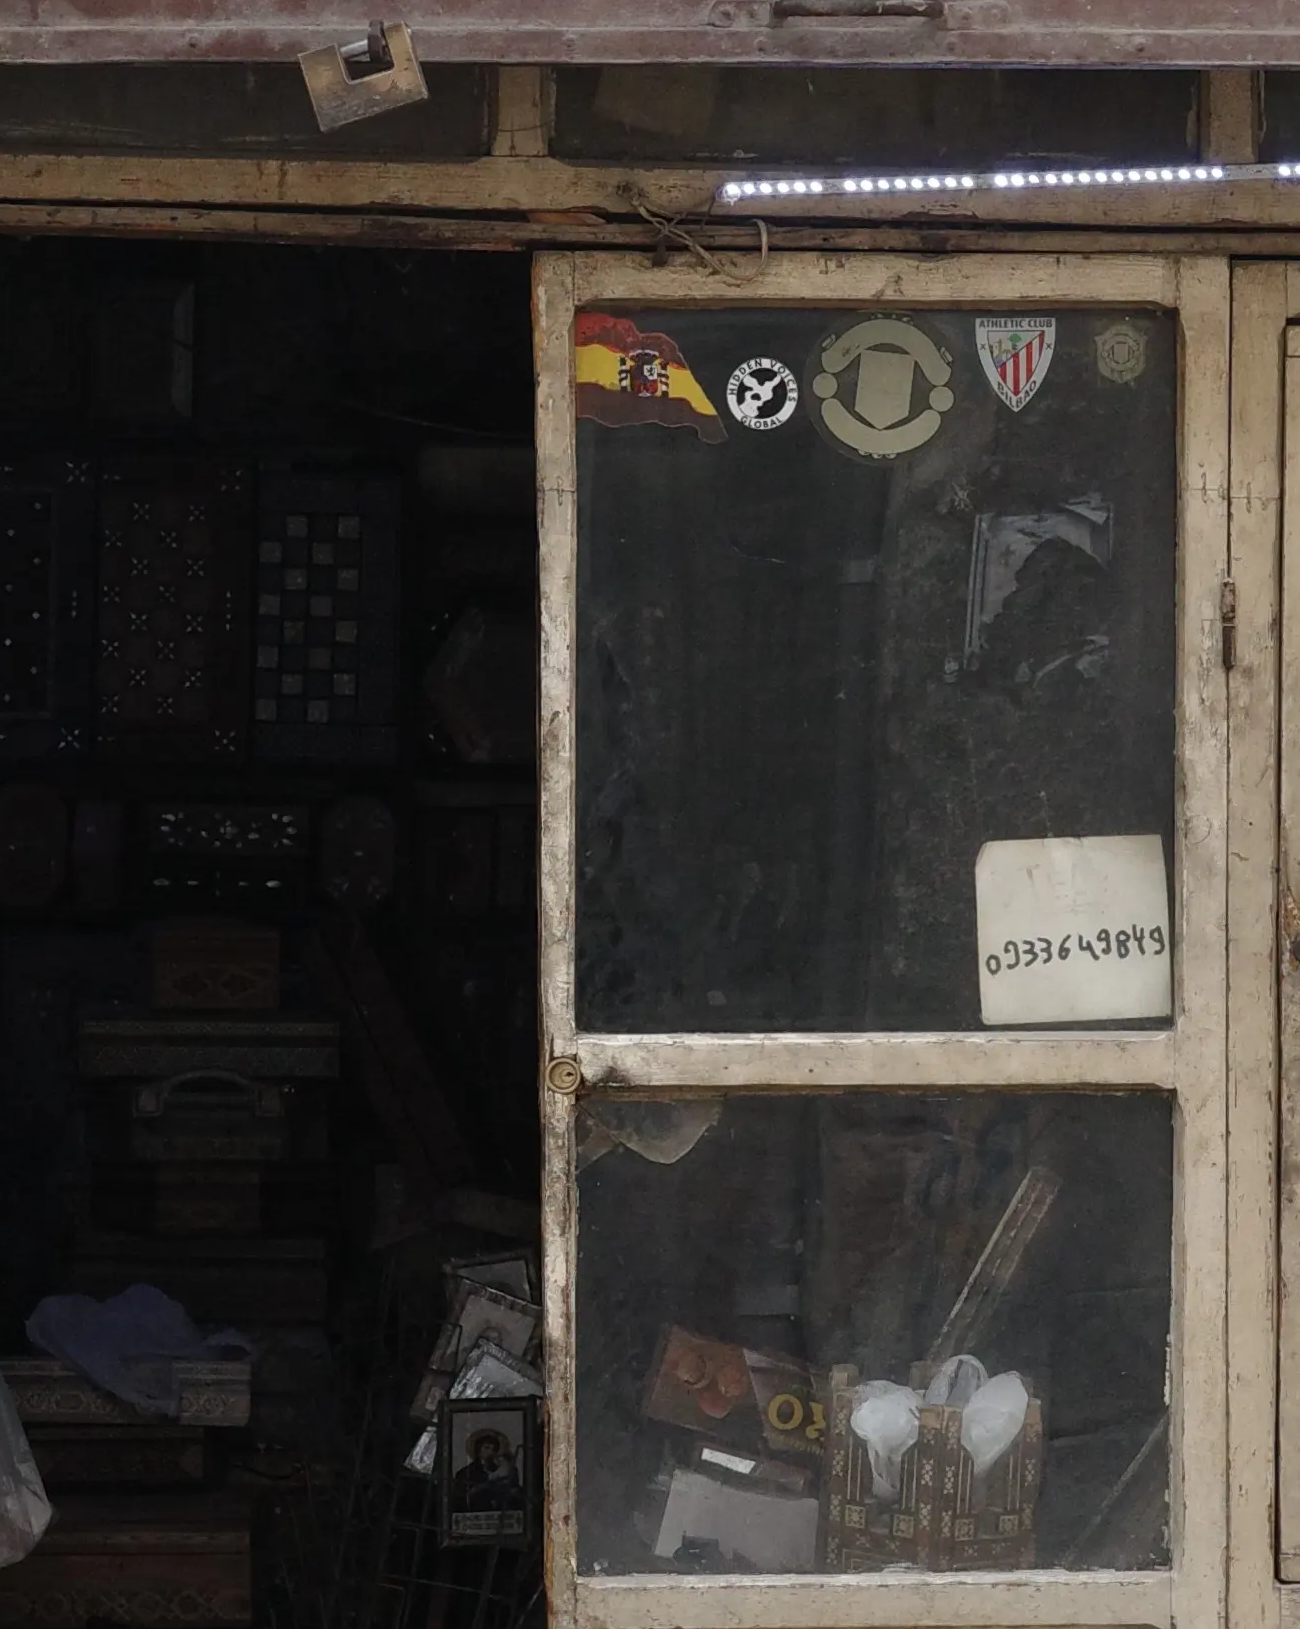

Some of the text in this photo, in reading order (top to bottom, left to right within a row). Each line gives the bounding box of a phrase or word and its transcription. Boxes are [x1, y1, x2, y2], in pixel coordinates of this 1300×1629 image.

[978, 318, 1053, 329] ATHLETIC CLUB
[728, 358, 797, 402] HIDDEN VOICES
[997, 380, 1037, 409] BILBAO
[740, 415, 782, 430] GLOBAL
